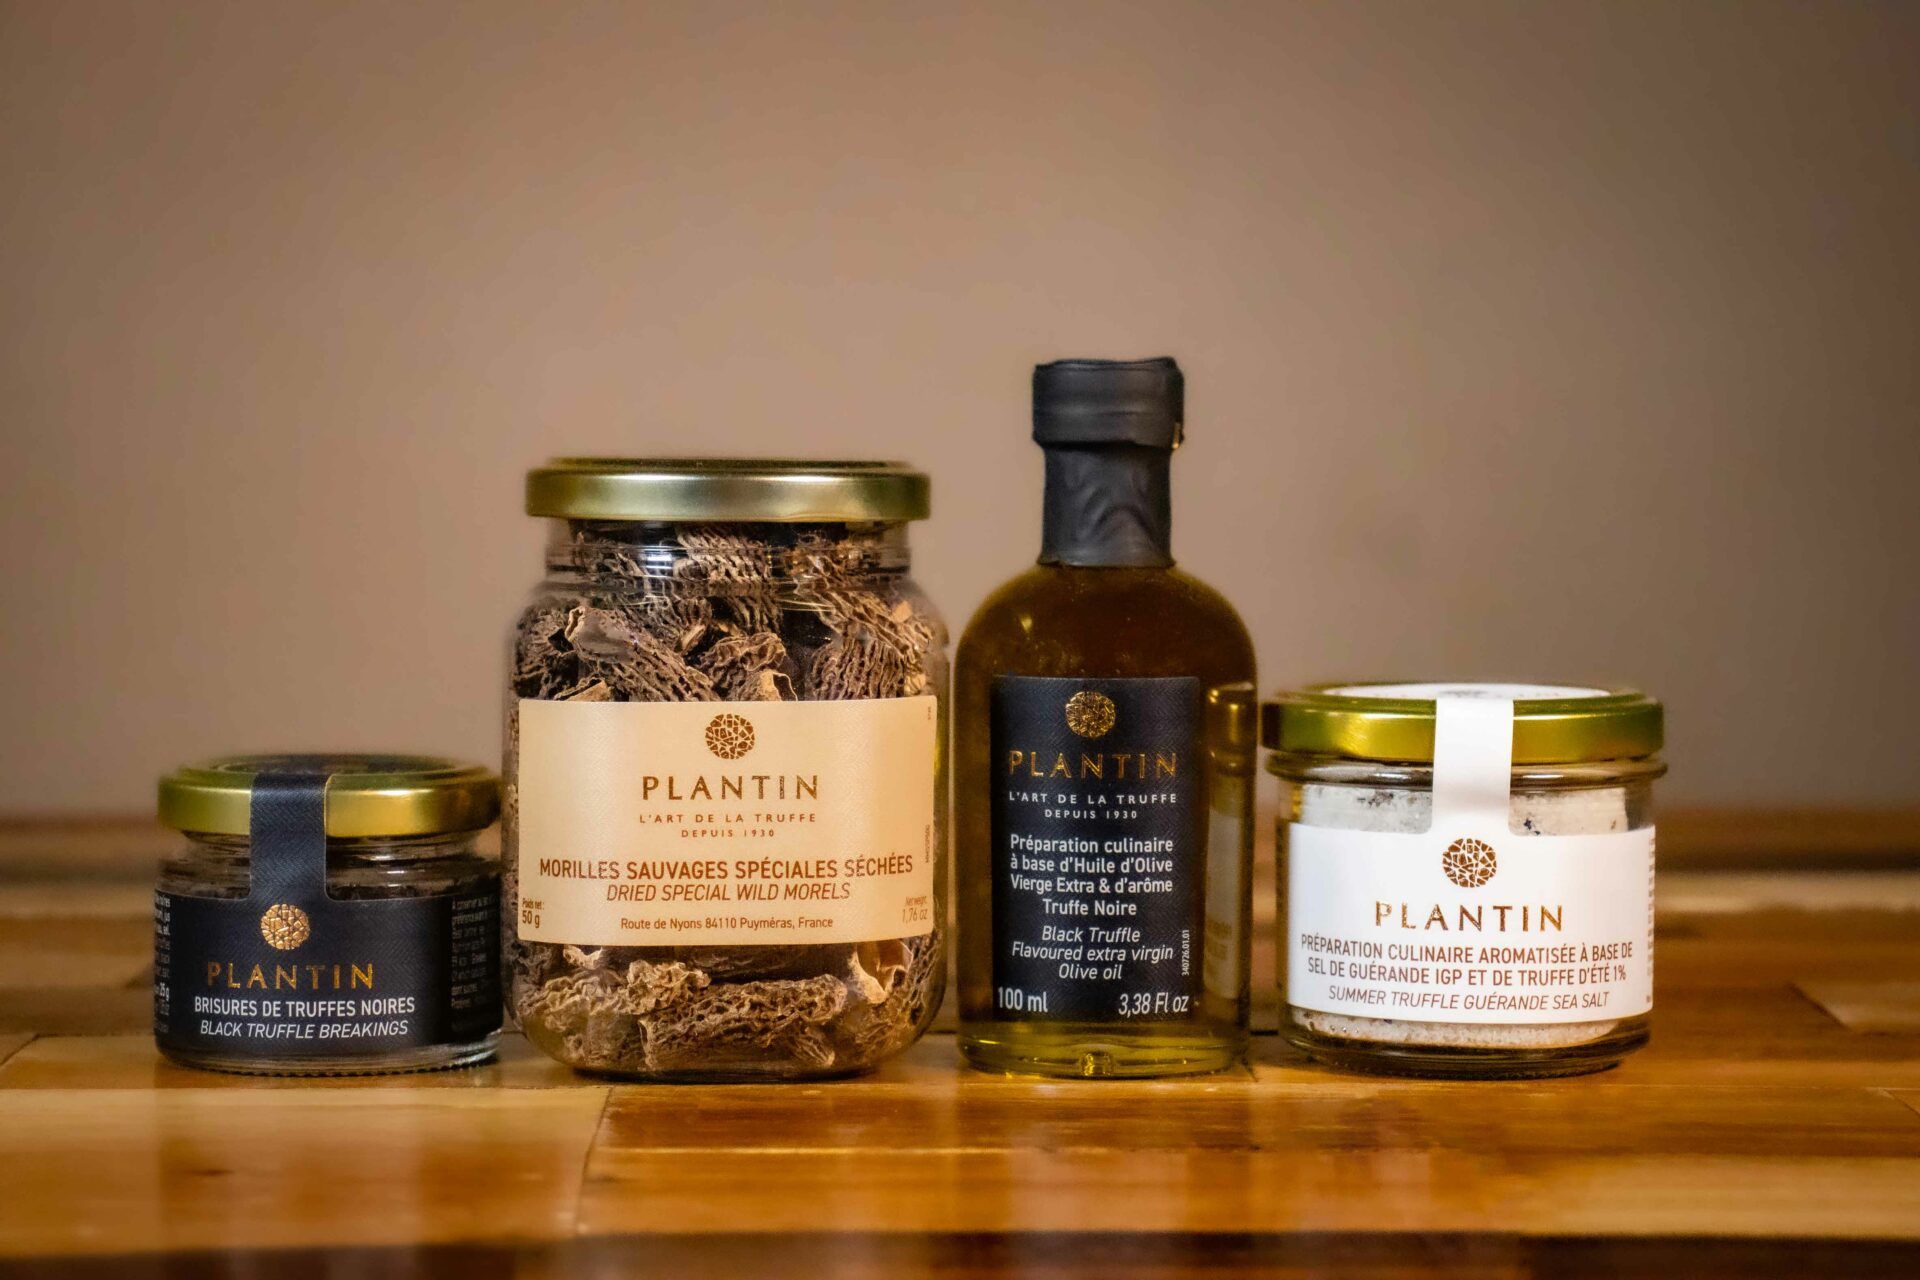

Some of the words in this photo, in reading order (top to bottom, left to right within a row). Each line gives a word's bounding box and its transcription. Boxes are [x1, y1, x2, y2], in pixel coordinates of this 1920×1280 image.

[1009, 751, 1177, 779] PLANTIN
[642, 775, 818, 800] PLANTIN
[1009, 791, 1048, 803] L'ART
[1058, 794, 1077, 804] DE
[1088, 795, 1107, 804] LA
[1117, 794, 1177, 804] TRUFFE
[640, 813, 684, 824] L'ART
[695, 814, 714, 824] DE
[725, 813, 745, 823] LA
[754, 813, 816, 823] TRUFFE
[1045, 809, 1096, 819] DEPUIS
[1107, 810, 1137, 819] 1930
[681, 829, 734, 838] DEPUIS
[744, 829, 775, 838] 1930
[1010, 834, 1098, 854] Préparation
[1104, 838, 1173, 853] culinaire
[539, 859, 620, 879] MORILLES
[626, 861, 728, 880] SAUVAGES
[735, 856, 837, 879] SPÉCIALES
[844, 852, 913, 878] SÉCHÉES
[1011, 854, 1018, 869] à
[1022, 856, 1054, 871] base
[1060, 858, 1115, 873] d'Huile
[1121, 857, 1173, 872] d'Olive
[606, 884, 657, 902] DRIED
[660, 884, 731, 901] SPECIAL
[736, 883, 779, 901] WILD
[784, 882, 850, 900] MORELS
[1011, 874, 1052, 896] Vierge
[1057, 878, 1094, 893] Extra
[1099, 879, 1111, 893] &
[1115, 877, 1173, 893] d'arôme
[902, 907, 918, 924] 1,76
[919, 908, 928, 920] oz
[1043, 899, 1089, 915] Truffe
[1095, 900, 1137, 916] Noire
[1375, 901, 1563, 932] PLANTIN
[522, 910, 532, 924] 50
[534, 914, 540, 928] g
[621, 917, 650, 929] Route
[654, 917, 667, 929] de
[670, 917, 702, 932] Nyons
[705, 917, 737, 929] 84110
[739, 917, 795, 931] Puyméras,
[799, 917, 833, 928] France
[1042, 925, 1083, 942] Black
[1089, 927, 1141, 942] Truffle
[1012, 942, 1082, 960] Flavoured
[1087, 948, 1126, 961] extra
[1131, 946, 1174, 964] virgin
[1182, 929, 1190, 976] 340726.01.01
[1301, 933, 1383, 959] PRÉPARATION
[1388, 945, 1473, 963] CULINAIRE
[1479, 943, 1575, 964] AROMATISÉE
[1580, 941, 1588, 962] À
[1592, 943, 1619, 961] BASE
[1621, 942, 1633, 959] DE
[207, 962, 373, 989] PLANTIN
[1059, 964, 1098, 979] Olive
[1103, 964, 1122, 979] oil
[1308, 957, 1326, 975] SEL
[1330, 961, 1345, 977] DE
[1349, 961, 1430, 983] GUÉRANDE
[1435, 968, 1462, 984] IGP
[1468, 969, 1487, 985] ET
[1493, 969, 1514, 986] DE
[1519, 969, 1574, 986] TRUFFE
[1579, 962, 1610, 984] D'ÉTÉ
[1613, 965, 1626, 981] 1%
[194, 996, 258, 1017] BRISURES
[262, 1001, 281, 1017] DE
[285, 1000, 355, 1018] TRUFFES
[361, 997, 415, 1015] NOIRES
[998, 987, 1023, 1010] 100
[1027, 992, 1048, 1013] ml
[1118, 993, 1152, 1016] 3,38
[1155, 992, 1170, 1013] Fl
[1172, 996, 1189, 1012] oz
[1329, 986, 1386, 1005] SUMMER
[1391, 991, 1459, 1009] TRUFFLE
[1464, 989, 1548, 1010] GUÉRANDE
[1553, 993, 1580, 1009] SEA
[1582, 991, 1609, 1008] SALT
[200, 1020, 242, 1037] BLACK
[247, 1023, 314, 1039] TRUFFLE
[319, 1020, 408, 1039] BREAKINGS
